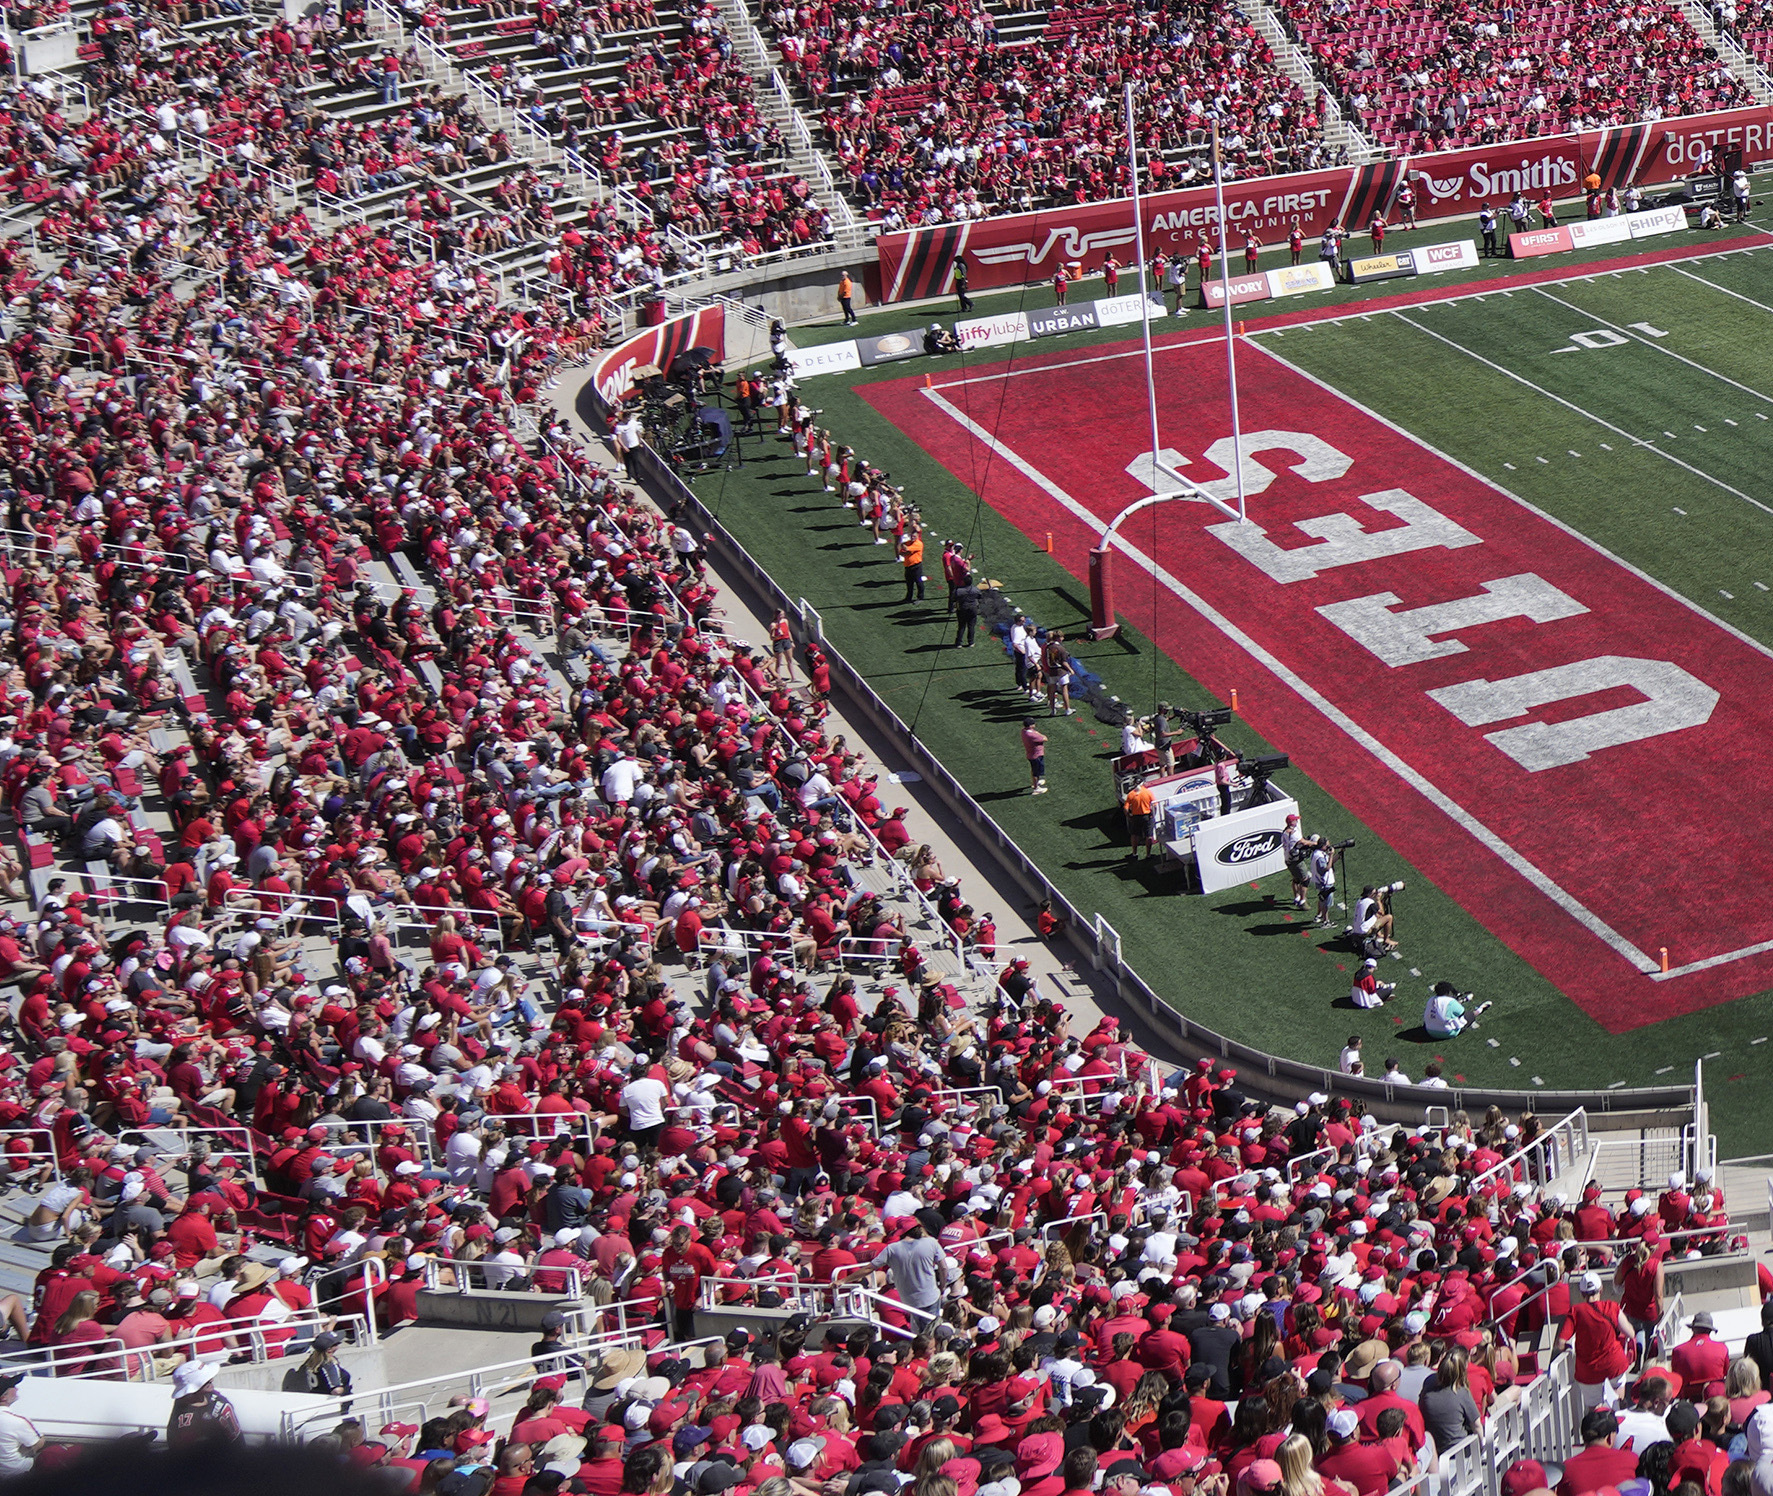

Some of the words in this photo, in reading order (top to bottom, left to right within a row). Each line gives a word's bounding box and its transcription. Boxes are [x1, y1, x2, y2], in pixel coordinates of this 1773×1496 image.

[1469, 155, 1577, 200] Smith's
[1151, 200, 1259, 233] AMERICA
[1263, 189, 1332, 217] FIRST
[1629, 206, 1684, 231] SHIPEX
[1170, 222, 1242, 242] CREDIT
[1254, 211, 1314, 230] UNION
[1521, 232, 1560, 247] UFIRST
[1360, 261, 1393, 272] Wheeler
[1430, 246, 1460, 260] WCF
[1228, 280, 1263, 296] IVORY
[959, 326, 991, 351] jiffy
[993, 320, 1025, 346] lube
[1033, 313, 1095, 334] URBAN
[1570, 320, 1670, 349] 10
[806, 351, 855, 367] DELTA
[1125, 429, 1720, 773] UTES
[1229, 834, 1275, 864] Ford
